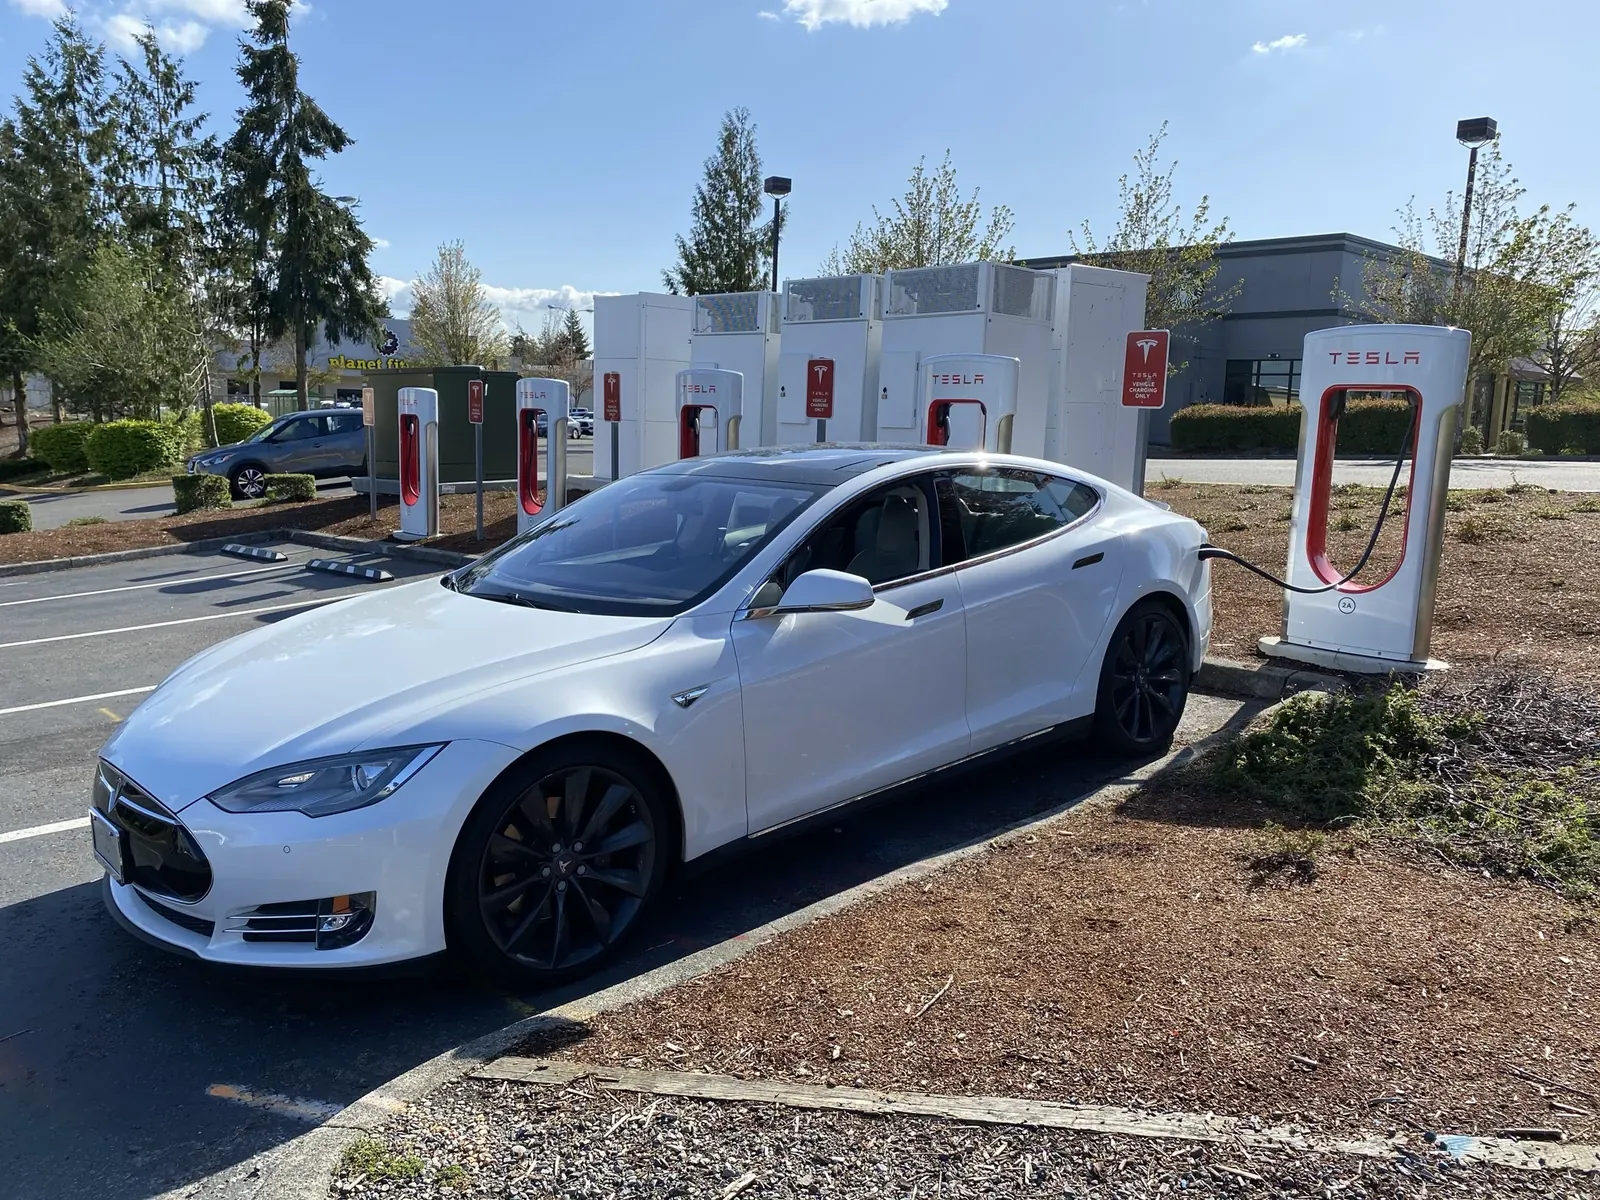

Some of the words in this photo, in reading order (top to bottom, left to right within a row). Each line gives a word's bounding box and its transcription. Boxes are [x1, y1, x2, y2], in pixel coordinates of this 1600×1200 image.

[328, 355, 382, 369] planet
[1328, 351, 1420, 365] TESLA
[932, 374, 984, 385] TESLA
[681, 384, 716, 393] TESLA
[520, 391, 546, 399] TESLA
